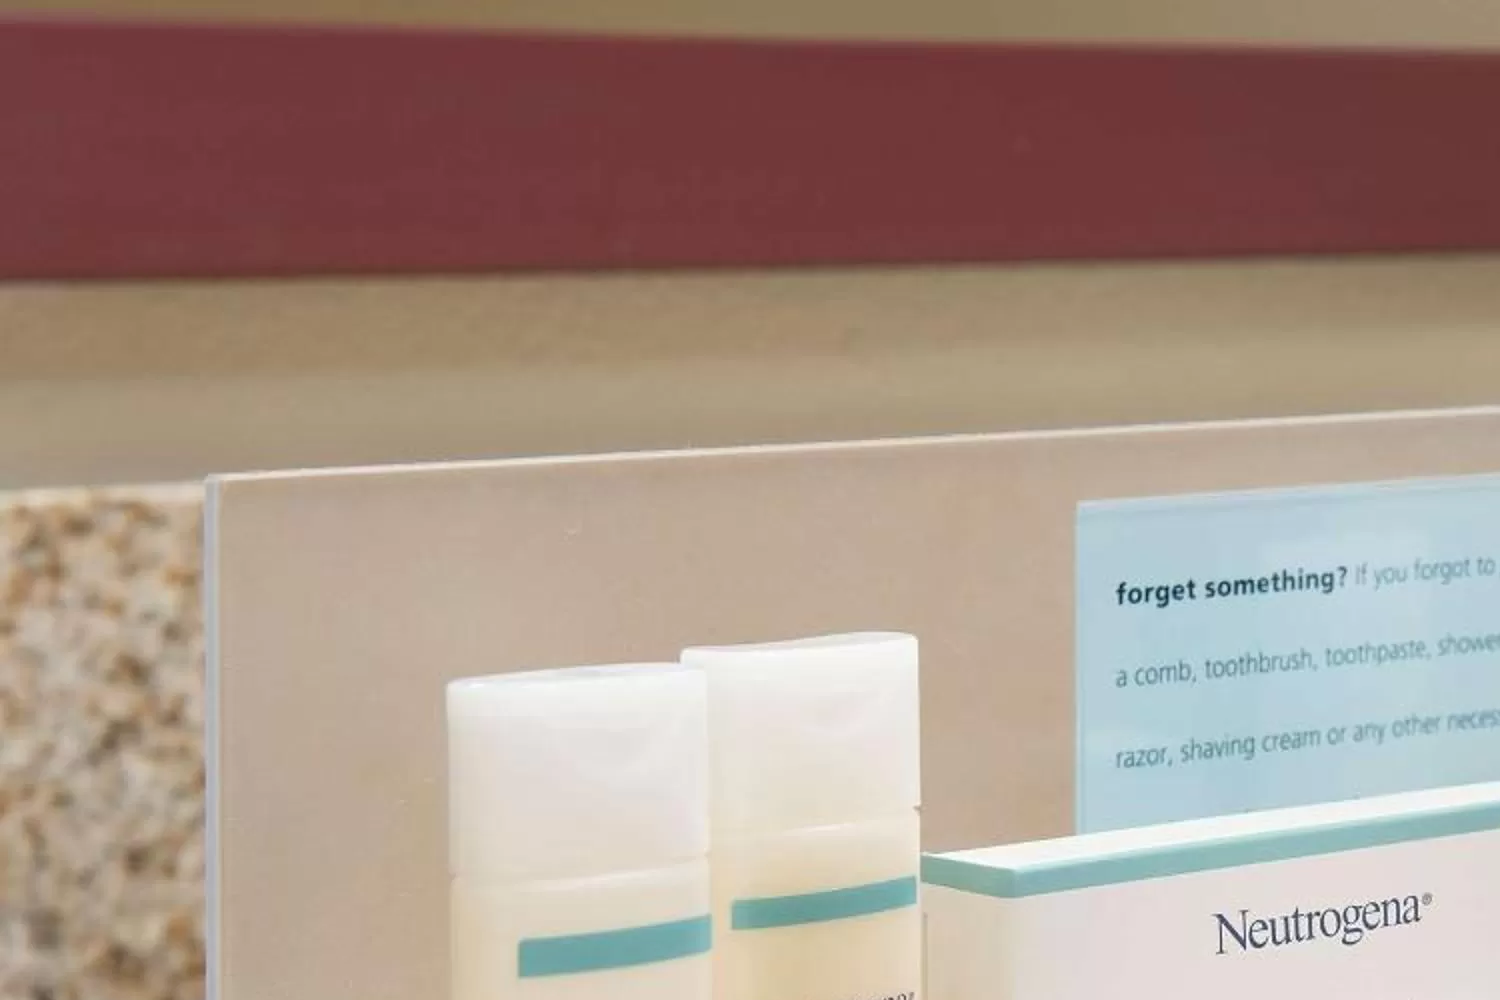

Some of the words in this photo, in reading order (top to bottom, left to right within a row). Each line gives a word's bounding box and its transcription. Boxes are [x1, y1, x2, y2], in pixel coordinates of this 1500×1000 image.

[1115, 578, 1197, 608] forget
[1204, 566, 1348, 598] something?
[1354, 562, 1368, 585] If
[1373, 566, 1407, 591] you
[1413, 557, 1472, 585] forgot
[1476, 556, 1496, 576] to
[1115, 669, 1128, 688] a
[1134, 659, 1197, 686] comb,
[1204, 648, 1319, 679] toothbrush,
[1325, 639, 1432, 668] toothpaste,
[1115, 746, 1173, 768] razor,
[1180, 738, 1256, 761] shaving
[1261, 729, 1321, 752] cream
[1327, 726, 1346, 745] or
[1352, 721, 1387, 746] any
[1391, 713, 1441, 738] other
